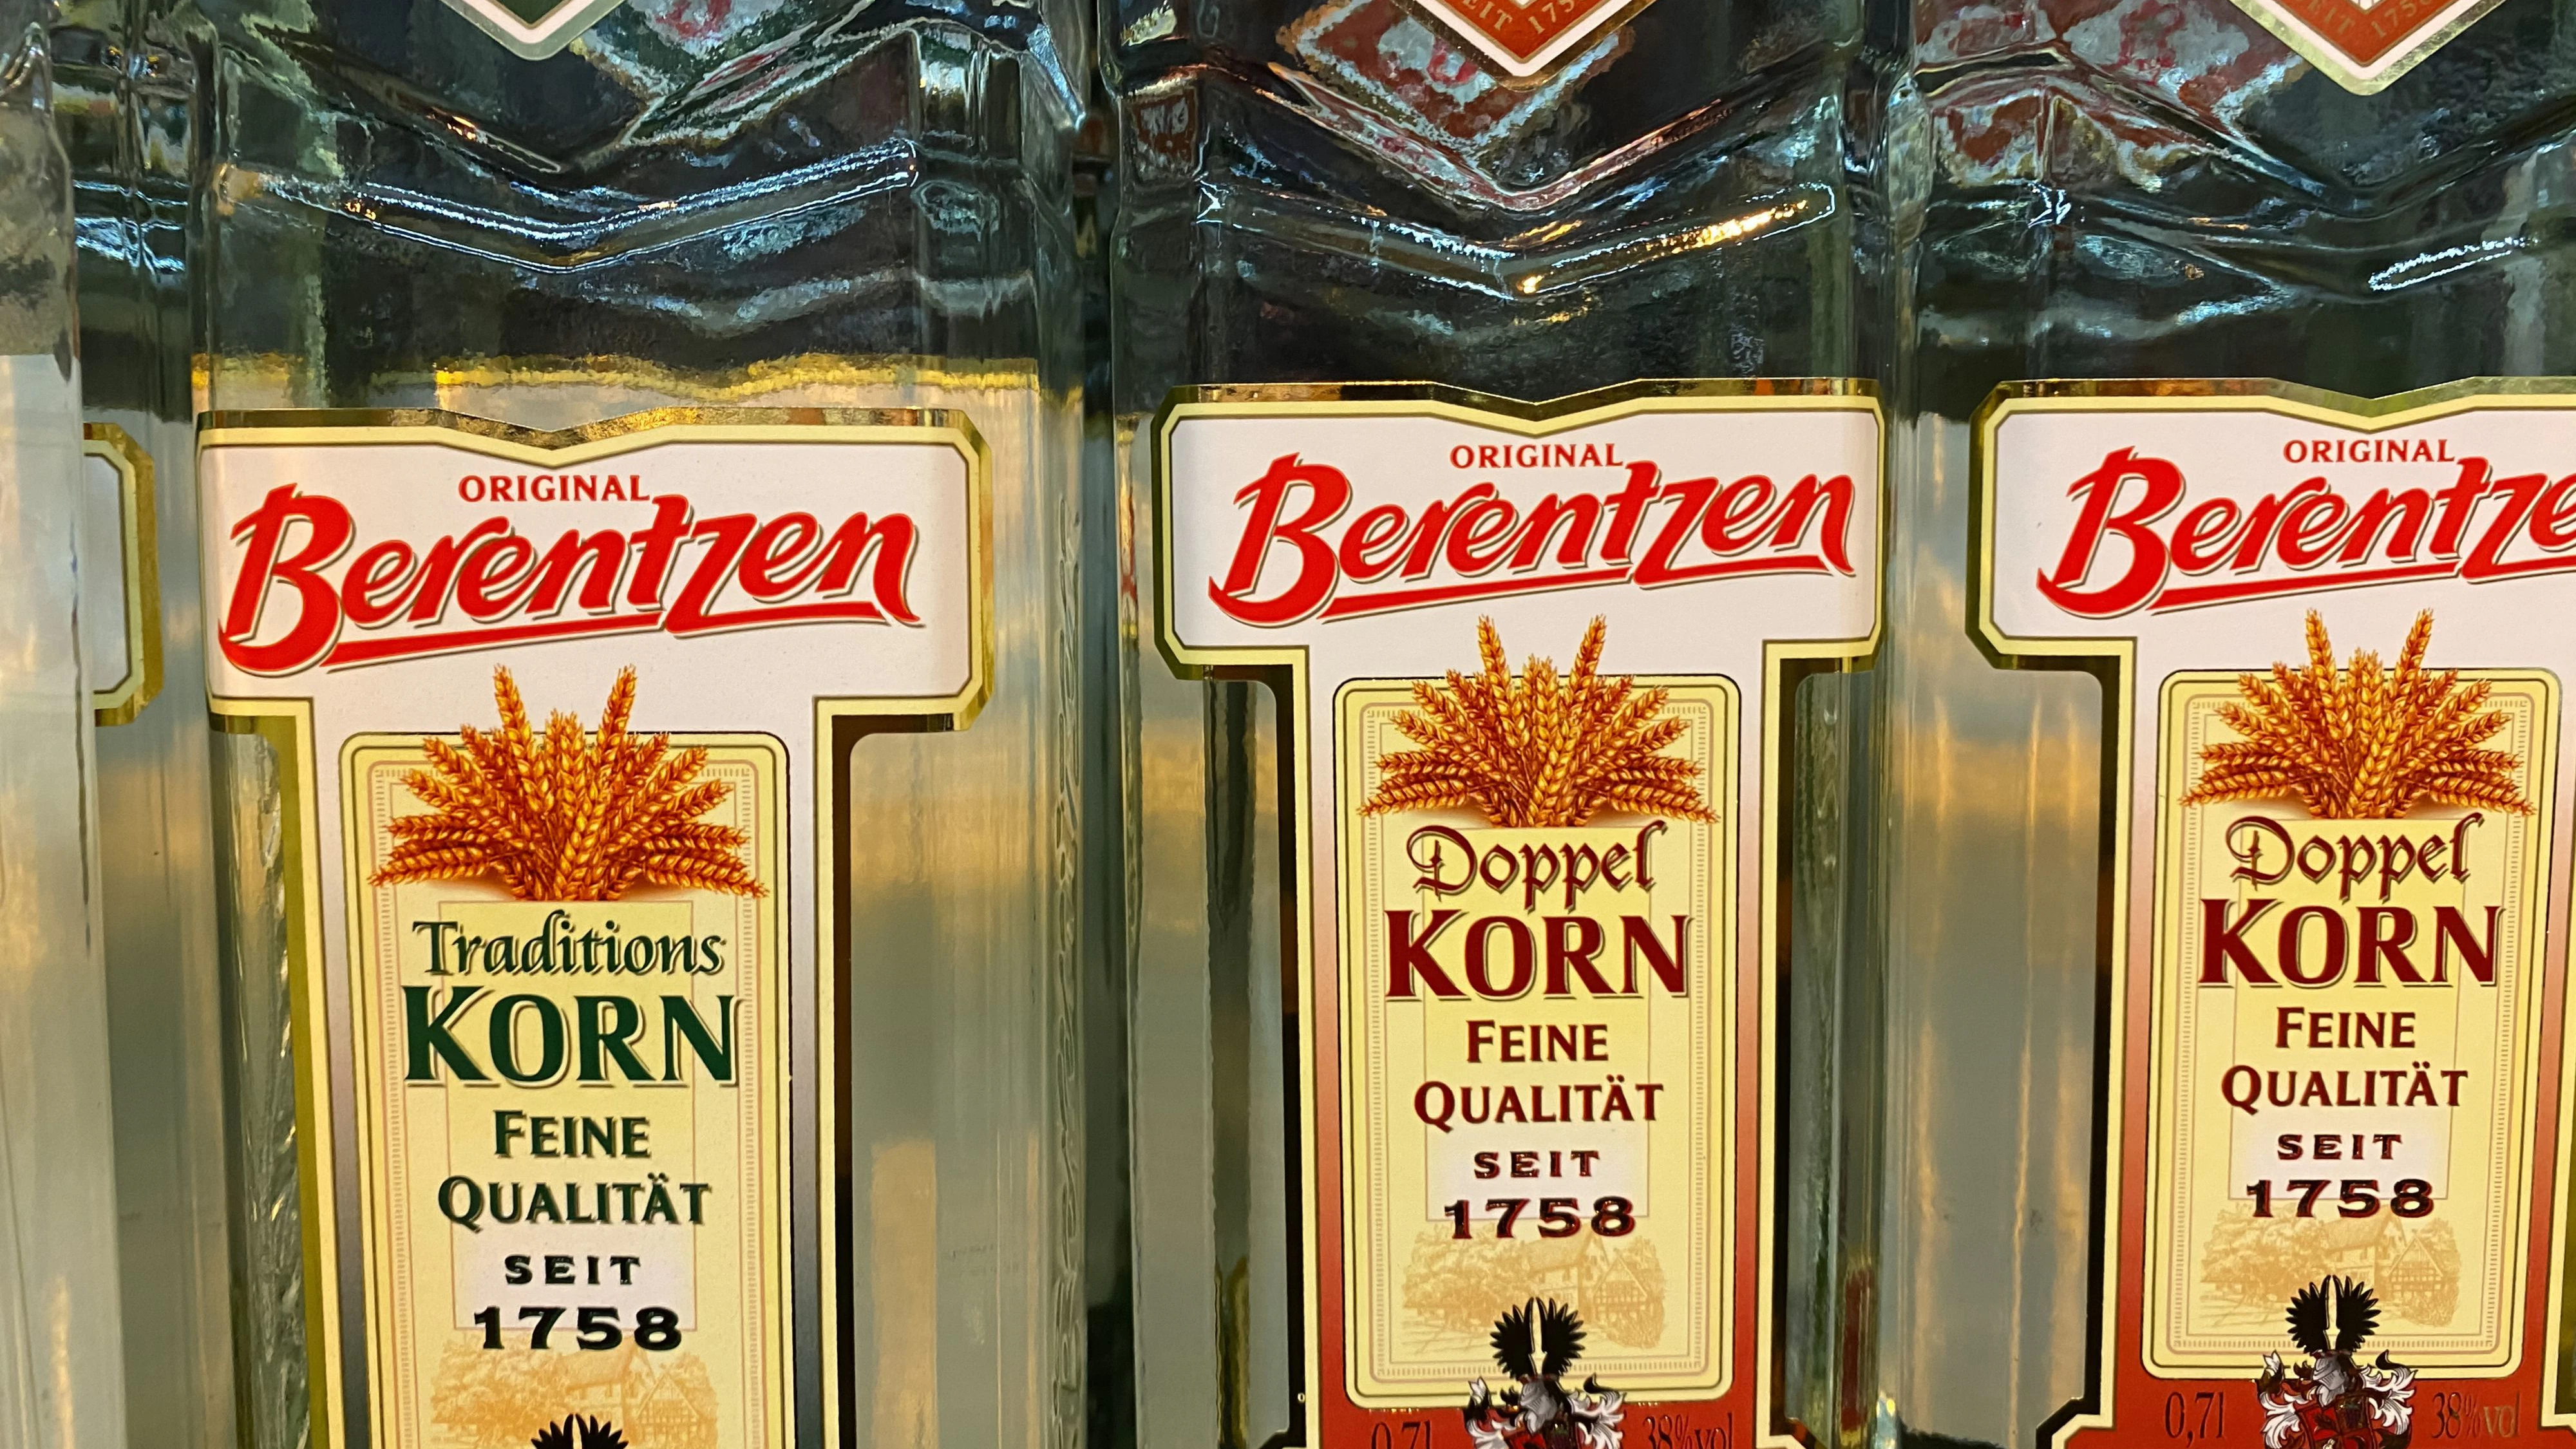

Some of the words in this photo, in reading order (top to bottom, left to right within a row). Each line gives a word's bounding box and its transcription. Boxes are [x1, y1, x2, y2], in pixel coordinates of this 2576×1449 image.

[2371, 0, 2432, 37] 175
[1449, 443, 1624, 468] ORIGINAL
[2284, 439, 2456, 463] ORIGINAL
[458, 475, 650, 502] ORIGINAL
[1208, 451, 1855, 627] Berentzen
[218, 483, 924, 677] Berentzen
[1406, 820, 1668, 914] Doppel
[2225, 812, 2485, 904] Doppel
[412, 909, 726, 976] Traditions
[1385, 909, 1694, 1001] KORN
[2198, 898, 2505, 989] KORN
[401, 985, 743, 1088] KORN
[1466, 1019, 1609, 1064] FEINE
[2275, 1007, 2416, 1048] FEINE
[1414, 1074, 1663, 1133] QUALITÄT
[2221, 1061, 2468, 1115] QUALITÄT
[493, 1110, 651, 1158] FEINE
[2277, 1133, 2403, 1160] SEIT
[1473, 1150, 1600, 1180] SEIT
[438, 1172, 712, 1233] QUALITÄT
[1443, 1195, 1636, 1240] 1758
[2246, 1179, 2436, 1219] 1758
[504, 1255, 641, 1285] SEIT
[474, 1306, 682, 1351] 1758
